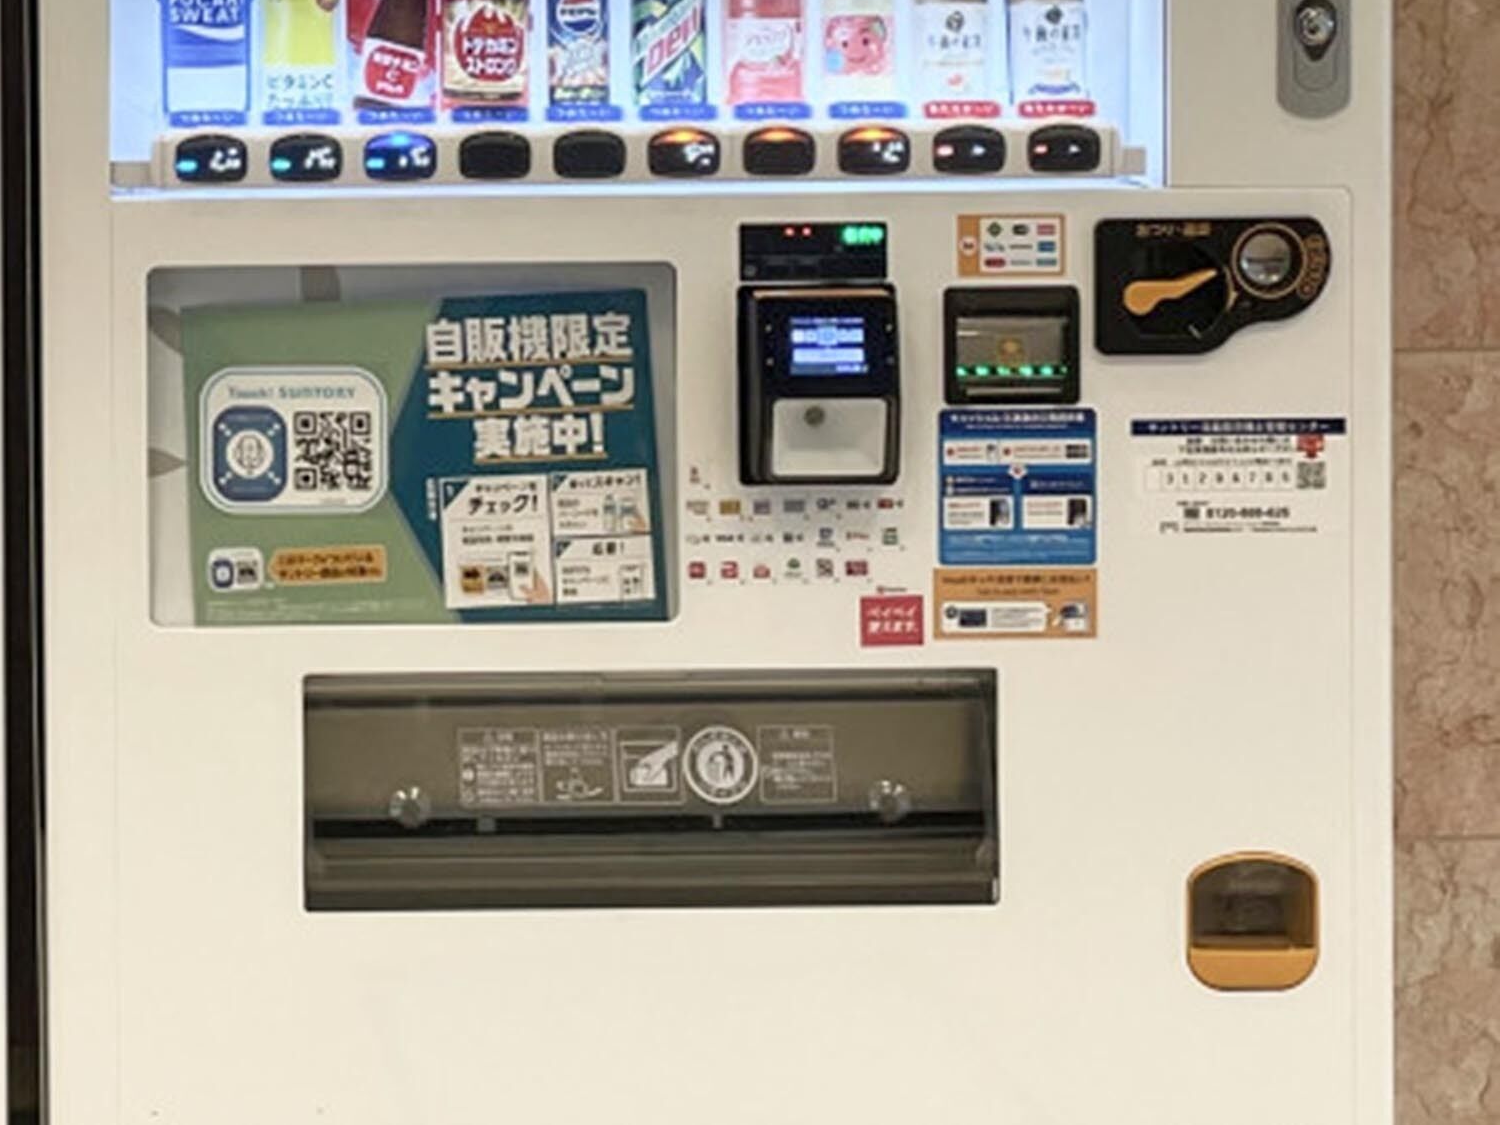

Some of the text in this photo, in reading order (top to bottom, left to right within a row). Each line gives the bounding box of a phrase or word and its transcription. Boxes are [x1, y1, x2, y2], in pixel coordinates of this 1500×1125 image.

[168, 7, 241, 24] SWEAT
[426, 311, 633, 364] 自販機限定
[428, 365, 635, 414] キャンペーン
